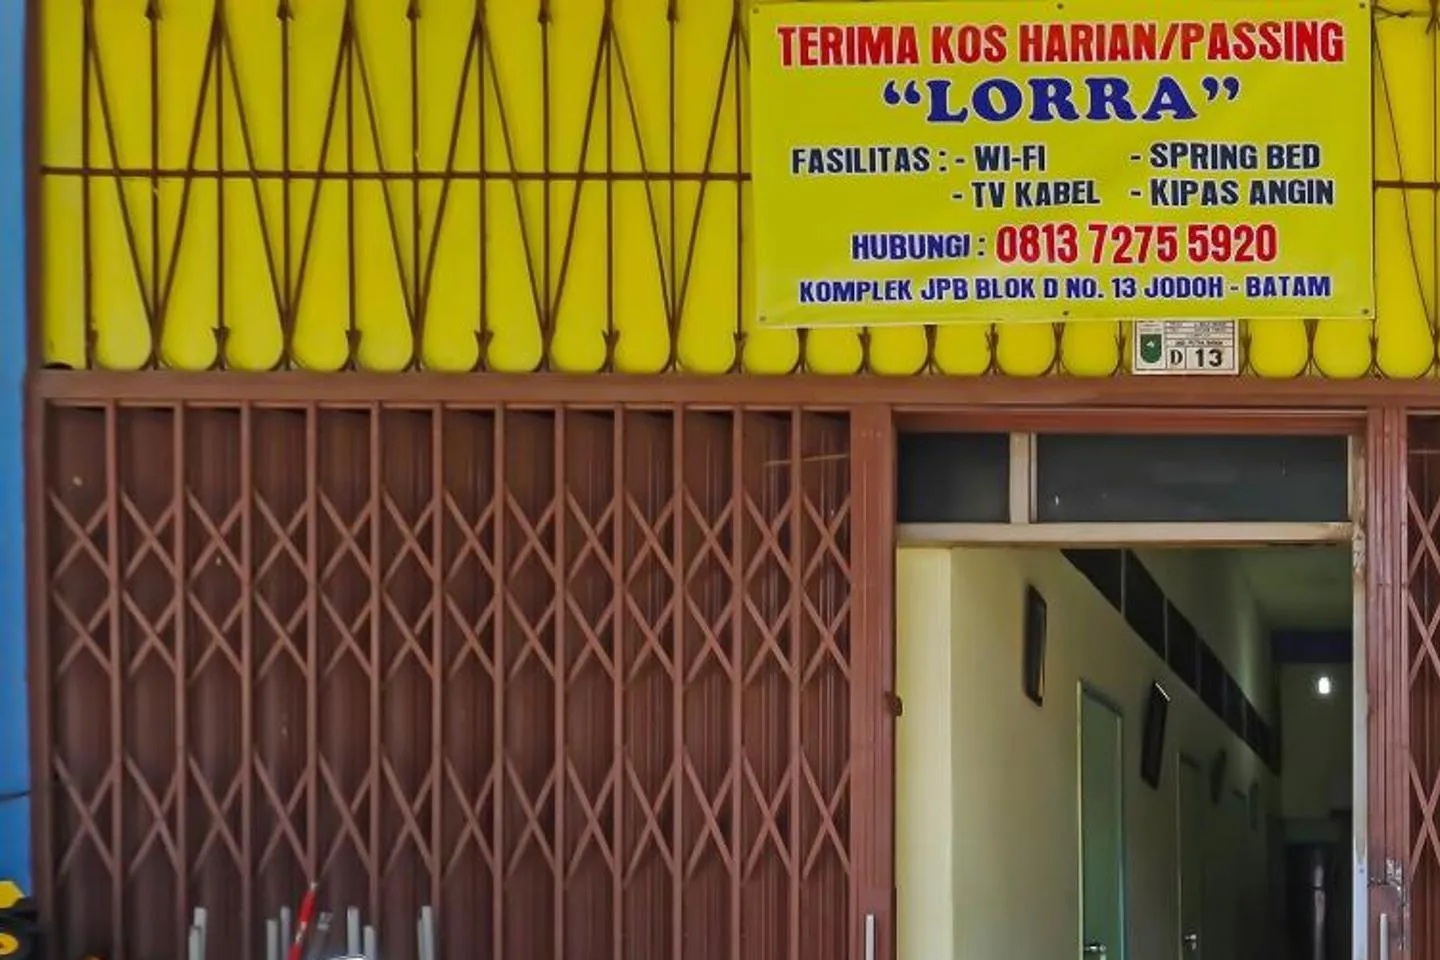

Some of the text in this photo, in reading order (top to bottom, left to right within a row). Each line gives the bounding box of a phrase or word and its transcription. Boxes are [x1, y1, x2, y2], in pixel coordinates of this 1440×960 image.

[776, 20, 1345, 67] TERIMA KOS HARIAN/PASSING
[792, 146, 930, 175] FASILITAS
[974, 144, 1046, 172] WI-FI
[1149, 141, 1258, 170] SPRING
[1266, 143, 1321, 170] BED
[971, 181, 1006, 208] TV
[1015, 179, 1101, 208] KABEL
[1150, 178, 1239, 207] KIPAS
[1249, 178, 1334, 206] ANGIN
[851, 233, 971, 260] HUBUNGI
[996, 222, 1078, 264] 0813
[1088, 223, 1178, 264] 7275
[1187, 223, 1278, 264] 5920
[799, 279, 913, 303] KOMPLEK
[920, 277, 969, 301] JPB
[975, 277, 1036, 300] BLOK
[1043, 277, 1059, 299] D
[1065, 277, 1105, 299] NO.
[1111, 276, 1137, 299] 13
[1143, 276, 1224, 299] JODOH
[1245, 275, 1331, 298] BATAM
[1170, 349, 1222, 367] D 13
